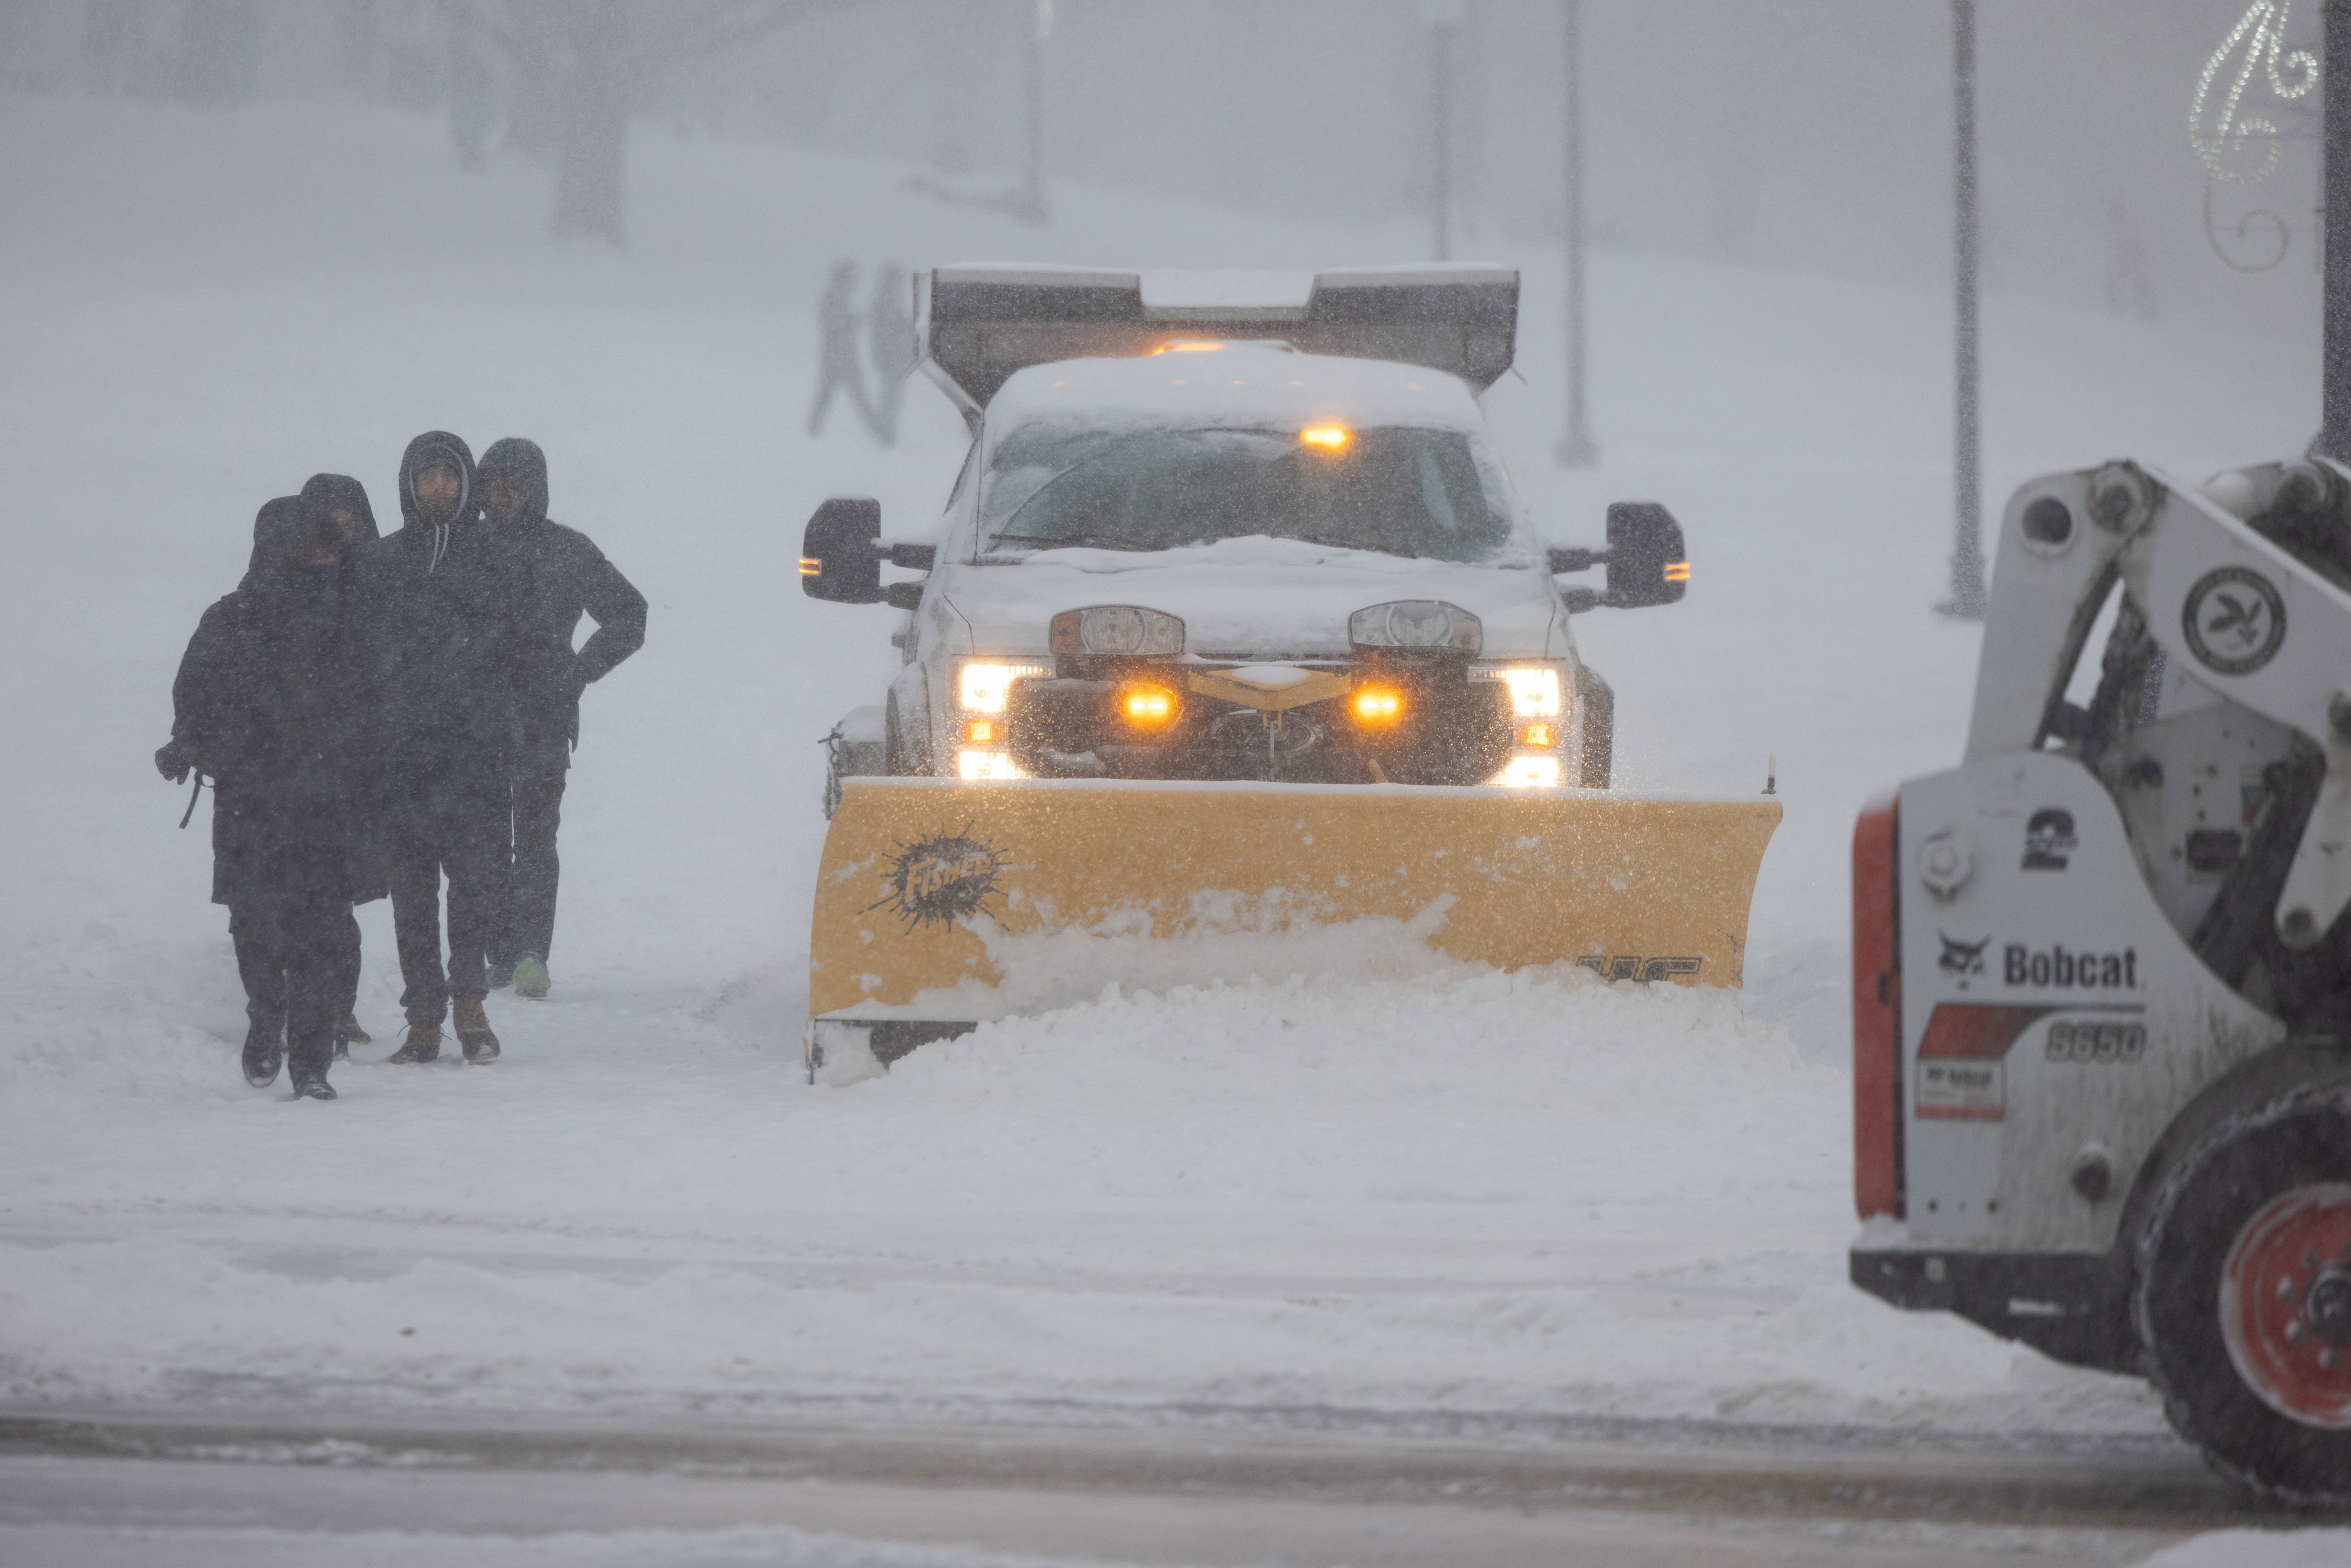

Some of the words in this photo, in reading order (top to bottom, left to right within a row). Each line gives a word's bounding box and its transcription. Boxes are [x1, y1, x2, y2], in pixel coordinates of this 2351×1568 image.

[905, 856, 994, 904] FISHER
[2005, 944, 2136, 988] Bobcat
[2046, 1021, 2146, 1063] S650
